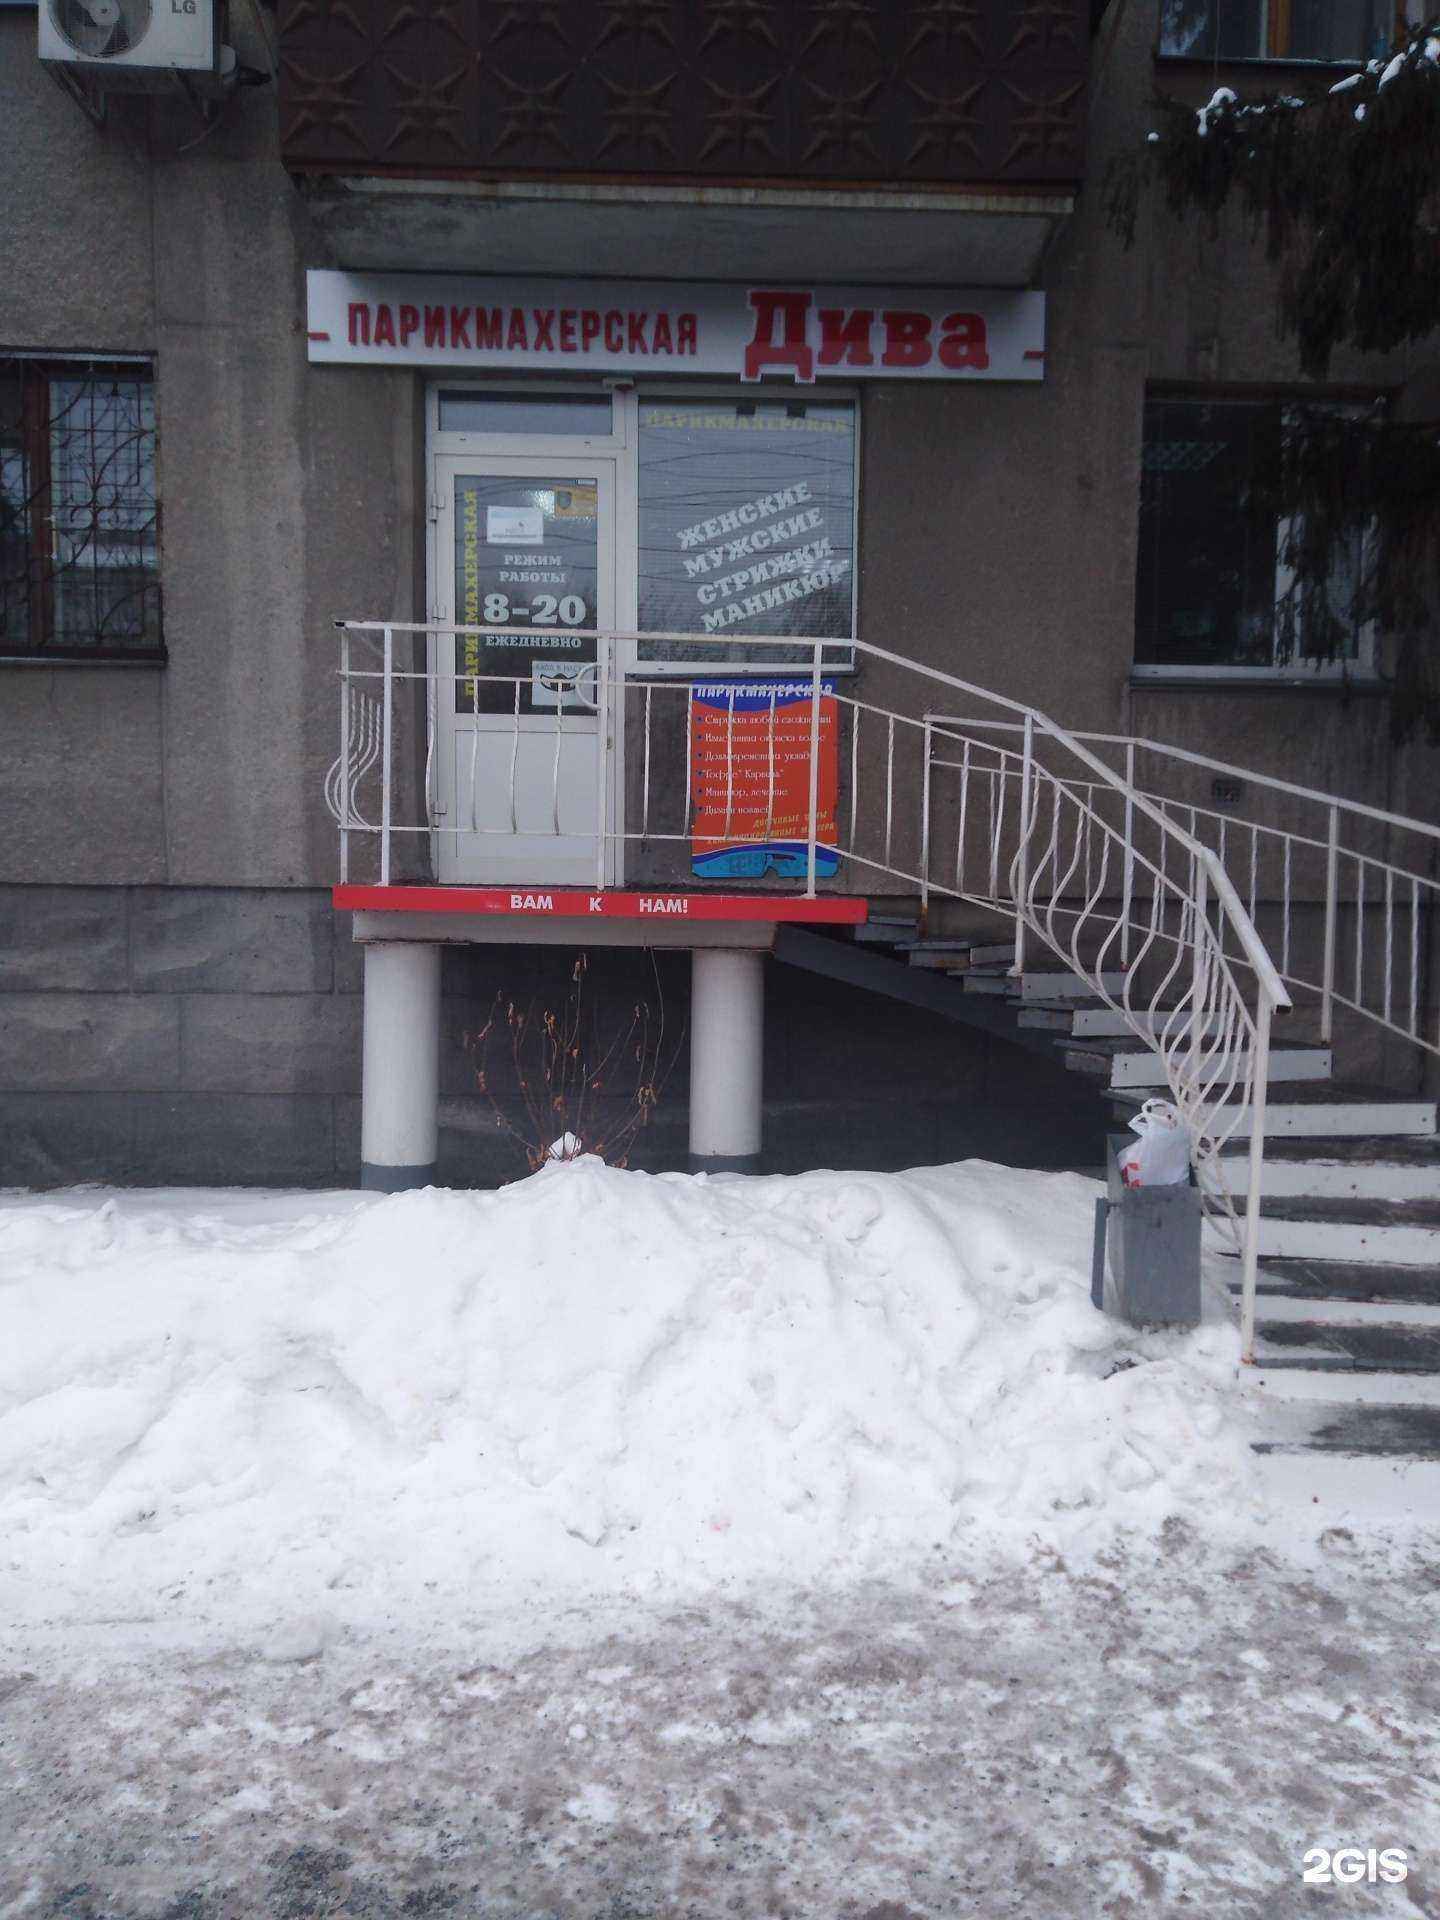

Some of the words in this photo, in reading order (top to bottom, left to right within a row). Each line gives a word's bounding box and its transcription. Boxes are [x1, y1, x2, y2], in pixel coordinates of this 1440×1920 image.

[171, 0, 196, 15] LG
[347, 302, 698, 356] ПАРИКМАХЕРСКАЯ
[741, 289, 991, 380] Дива
[676, 480, 813, 550] ЖЕНСКИЕ
[683, 507, 824, 578] МУЖСКИЕ
[503, 554, 563, 567] РЕЖИМ
[697, 537, 834, 605] СТРИЖКИ
[499, 571, 568, 583] РАБОТЫ
[464, 489, 479, 697] ПАРИМАХЕРСКАЯ
[701, 559, 850, 632] МАНИКЮР
[483, 592, 586, 625] 8-20
[485, 635, 582, 648] ЕЖЕДНЕВНО
[697, 684, 833, 698] ПАРИКМАХЕРСКЯ
[749, 715, 779, 725] любй
[510, 894, 553, 910] ВАМ
[589, 897, 602, 912] К
[639, 898, 688, 914] НАМ!
